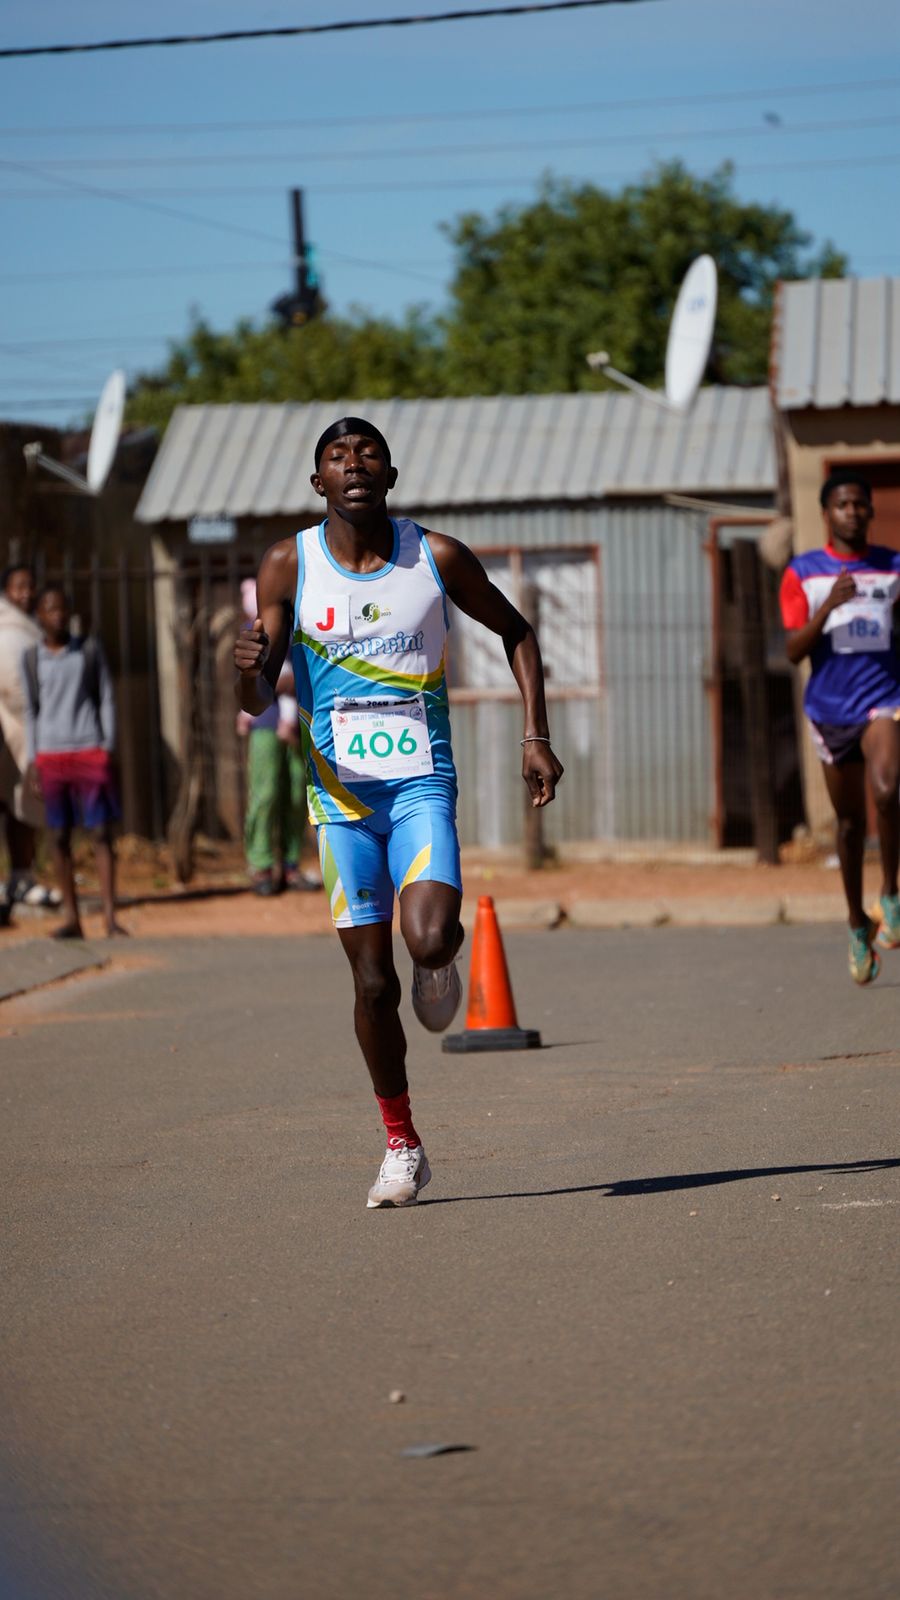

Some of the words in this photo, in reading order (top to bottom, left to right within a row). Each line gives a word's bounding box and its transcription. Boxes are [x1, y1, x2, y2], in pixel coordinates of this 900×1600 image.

[315, 607, 335, 632] J
[848, 618, 880, 638] 182
[347, 728, 417, 760] 406
